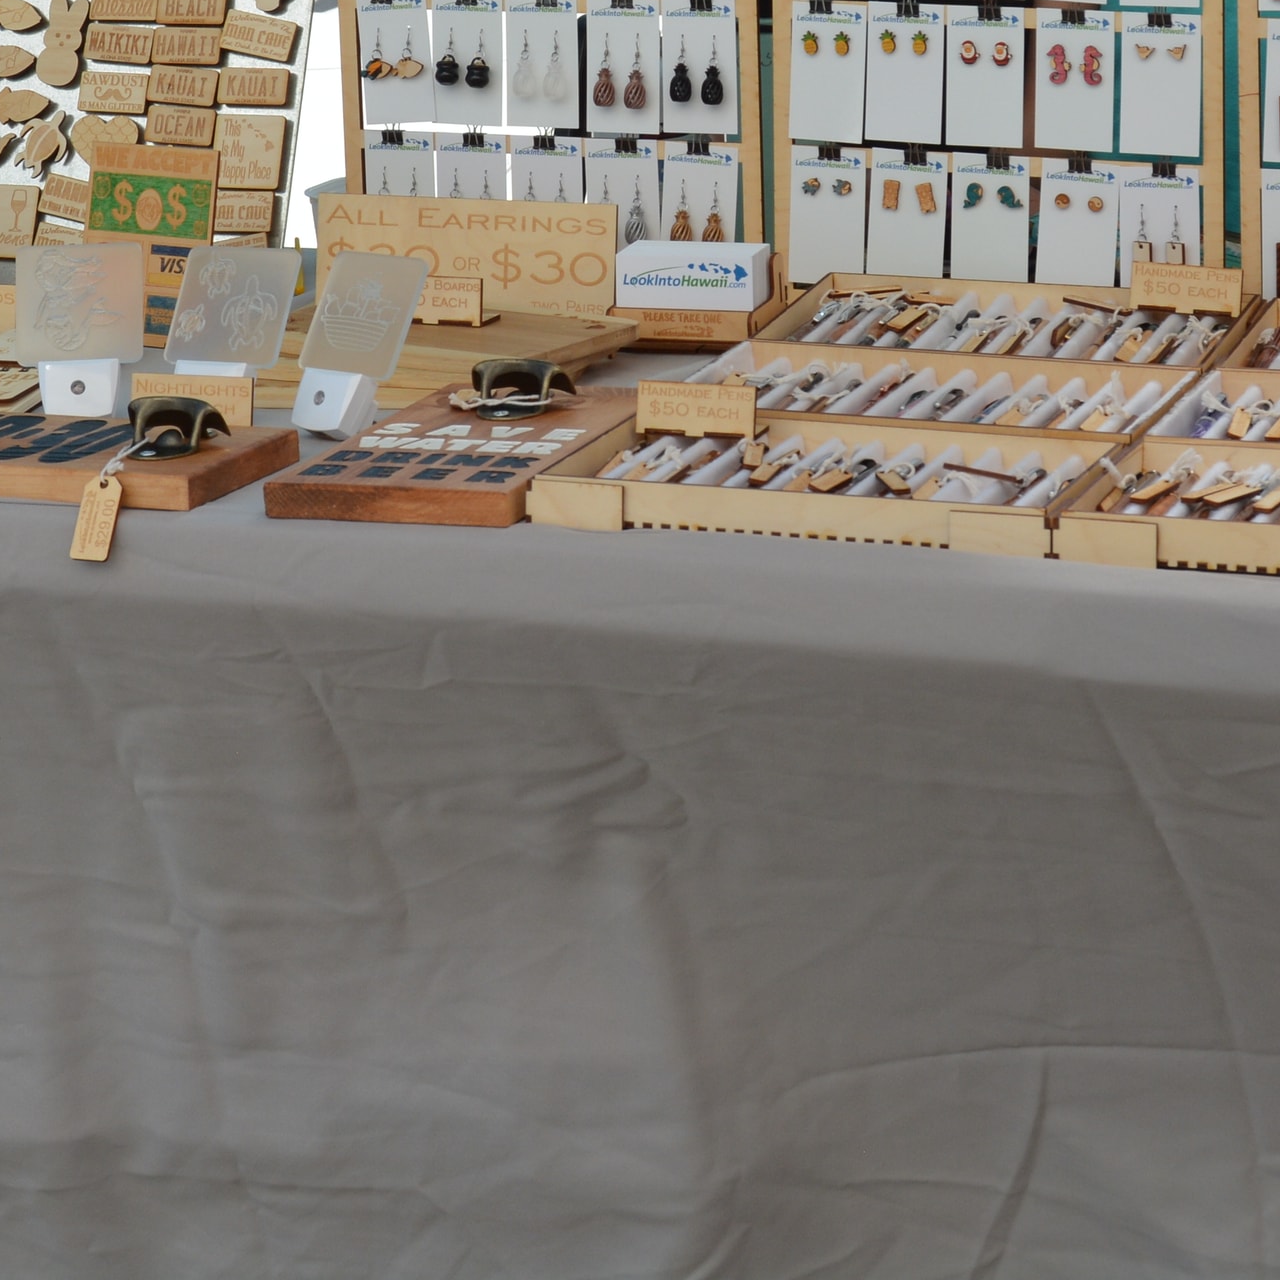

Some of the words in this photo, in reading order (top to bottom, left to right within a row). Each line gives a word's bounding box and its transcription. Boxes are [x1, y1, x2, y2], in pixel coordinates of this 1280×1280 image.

[90, 34, 149, 56] WAIKIKI
[326, 204, 398, 226] ALL
[453, 256, 480, 272] OR
[491, 243, 607, 290] $30
[623, 274, 746, 288] LookIntoHawaii.com
[1143, 279, 1181, 297] $50
[1188, 286, 1228, 300] EACH
[373, 422, 587, 441] SAVE
[356, 436, 562, 456] WATER
[325, 450, 541, 469] DRINK
[299, 465, 518, 484] BEER
